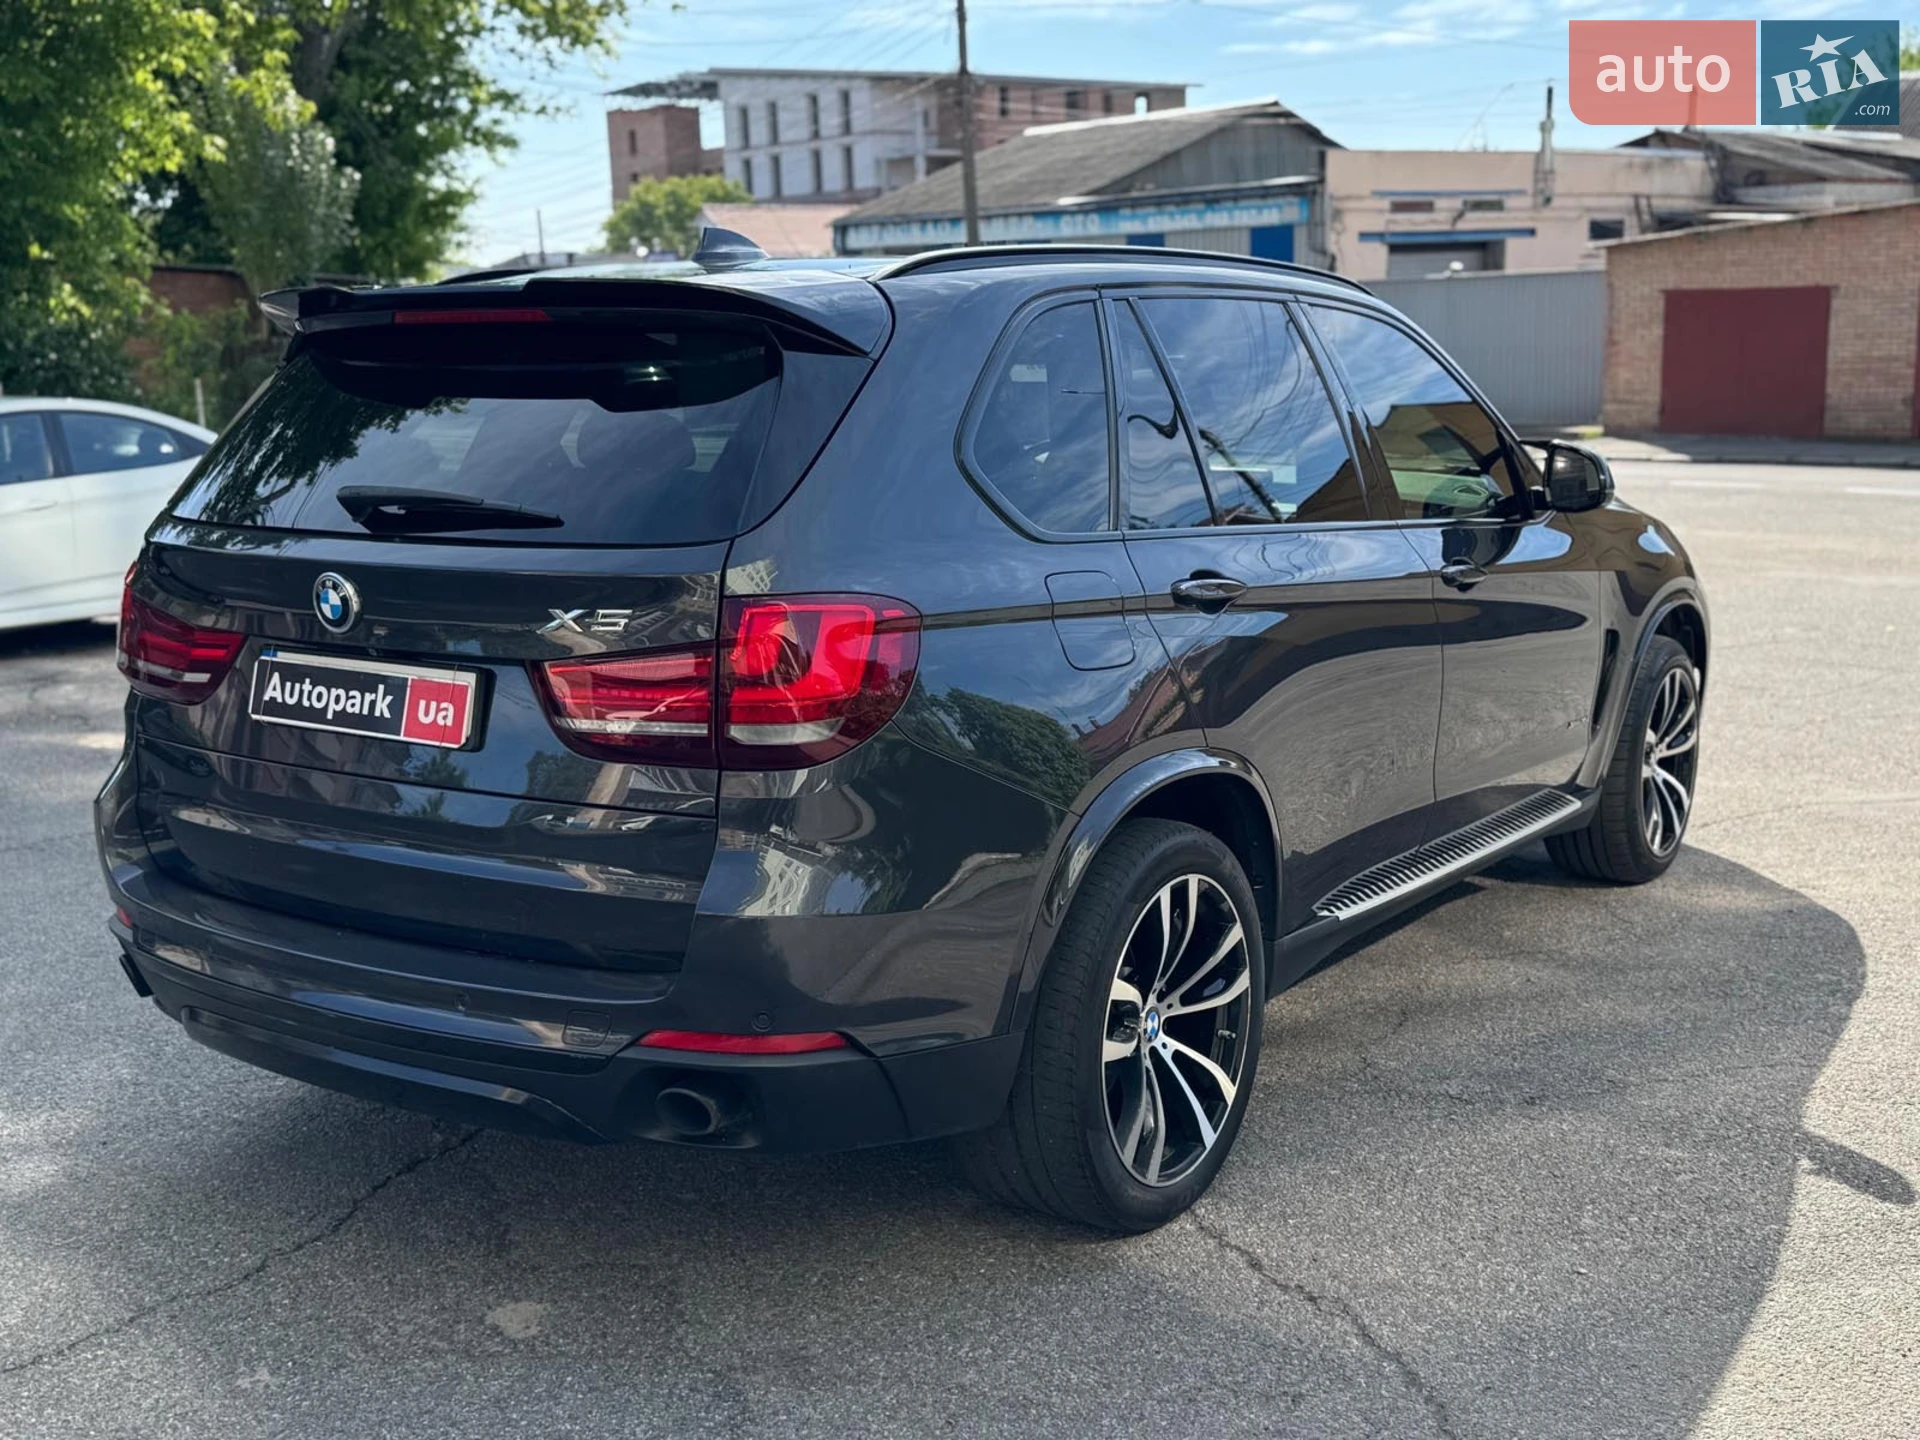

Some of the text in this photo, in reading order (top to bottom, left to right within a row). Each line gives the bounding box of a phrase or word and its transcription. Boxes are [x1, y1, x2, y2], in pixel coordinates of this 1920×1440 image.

[536, 608, 633, 634] X5
[263, 671, 454, 727] Autopark ua
